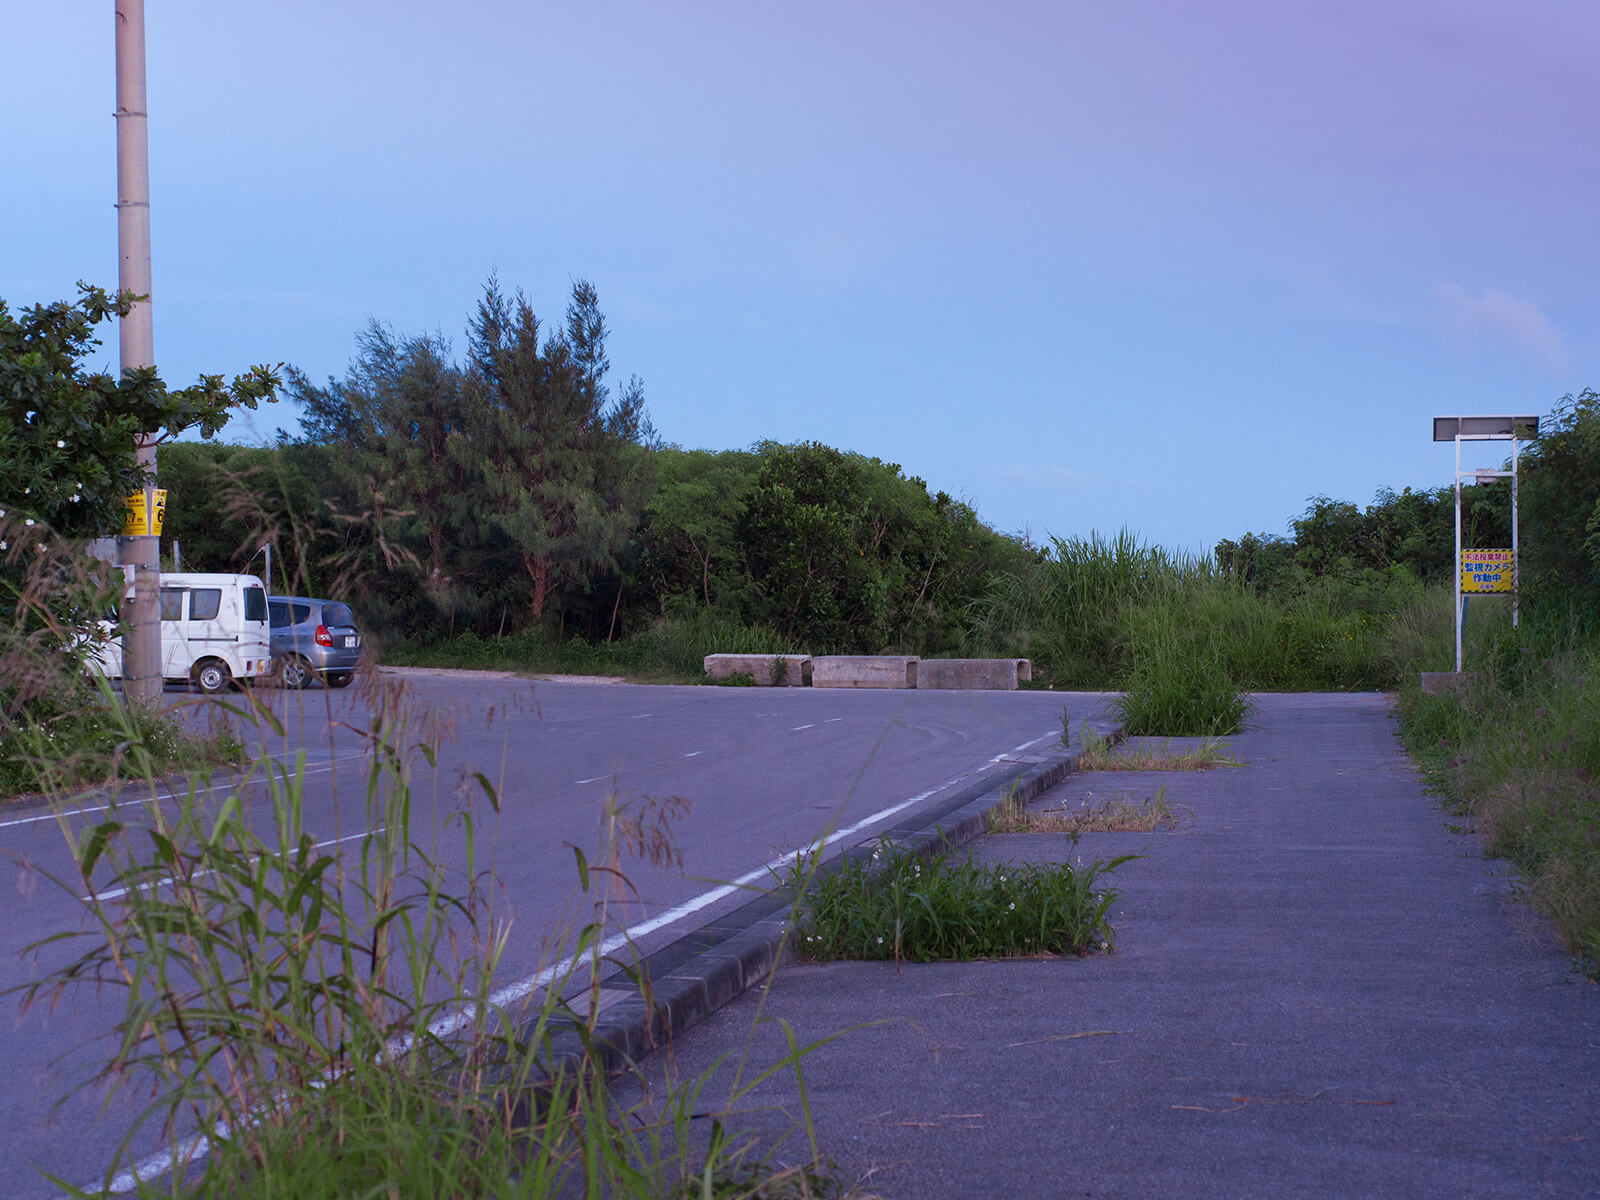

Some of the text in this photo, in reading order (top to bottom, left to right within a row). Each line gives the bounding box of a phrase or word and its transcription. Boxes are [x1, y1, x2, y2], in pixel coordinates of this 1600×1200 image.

[1464, 553, 1509, 561] 不法投棄禁止
[1465, 563, 1510, 572] 監視カメラ
[1473, 573, 1502, 583] 作動中
